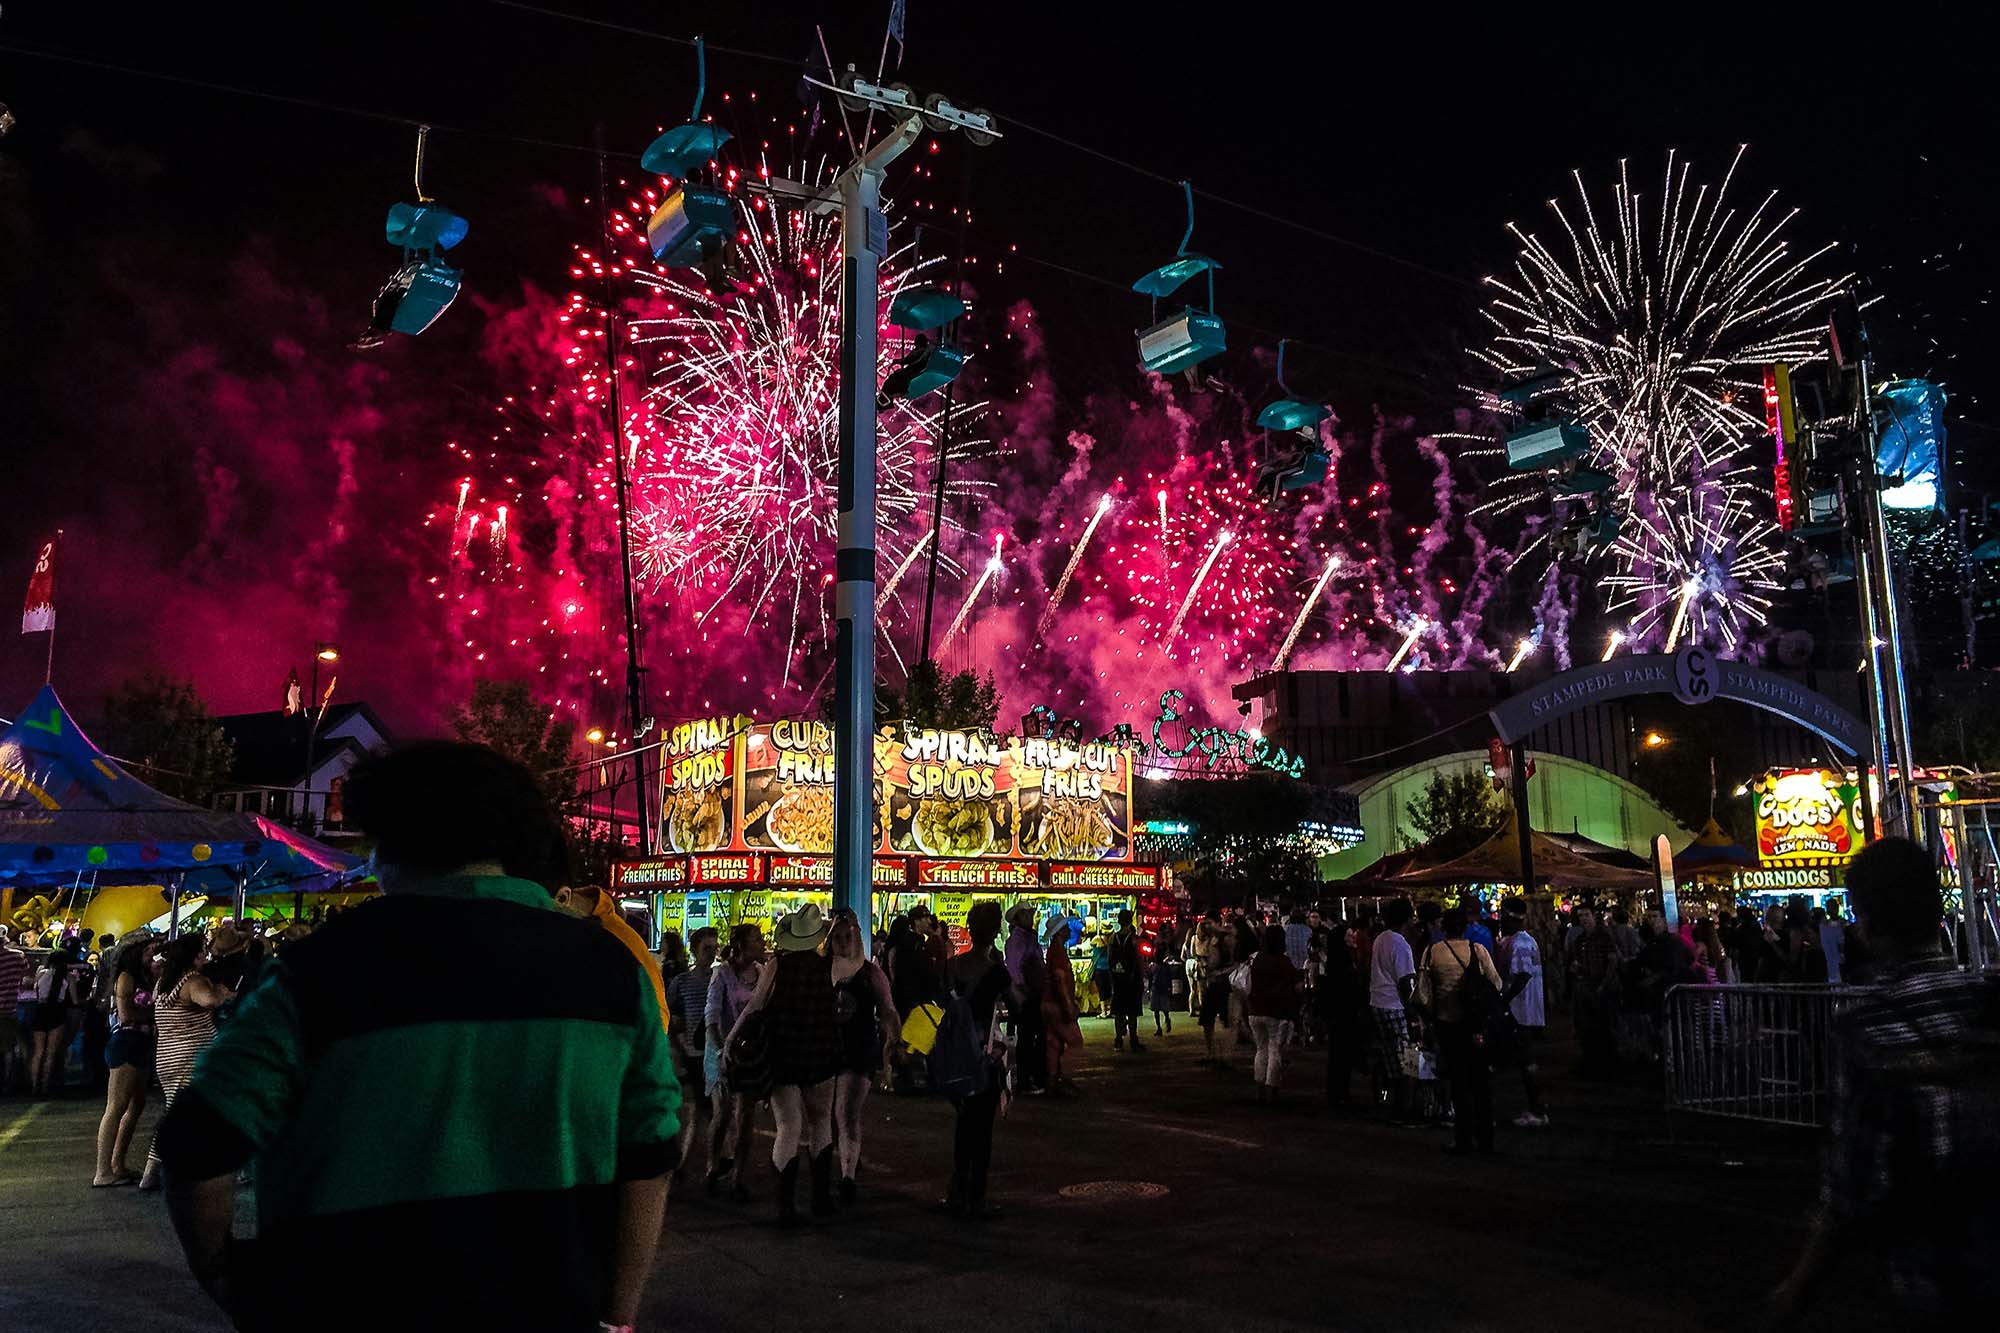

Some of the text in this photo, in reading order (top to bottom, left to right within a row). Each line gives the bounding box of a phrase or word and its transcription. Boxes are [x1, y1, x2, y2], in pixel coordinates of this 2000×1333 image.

[1531, 666, 1668, 715] STAMPEDE PARK
[1727, 671, 1851, 736] STAMPEDE PARK
[670, 716, 730, 757] SPIRAL
[770, 719, 835, 752] CUR
[902, 729, 1001, 766] SPIRAL
[672, 750, 726, 791] SPUDS
[776, 751, 835, 784] FRIE
[1025, 739, 1119, 773] FREH-CUT
[907, 764, 995, 799] SPUDS
[1043, 770, 1103, 802] FRIES
[1772, 806, 1833, 828] DOGS
[623, 868, 681, 884] FRENCH FRIES
[701, 858, 749, 869] SPIRAL
[701, 869, 748, 881] SPUDS
[933, 870, 1026, 884] FRENCH FRIES
[1743, 869, 1831, 888] CORNDOGS
